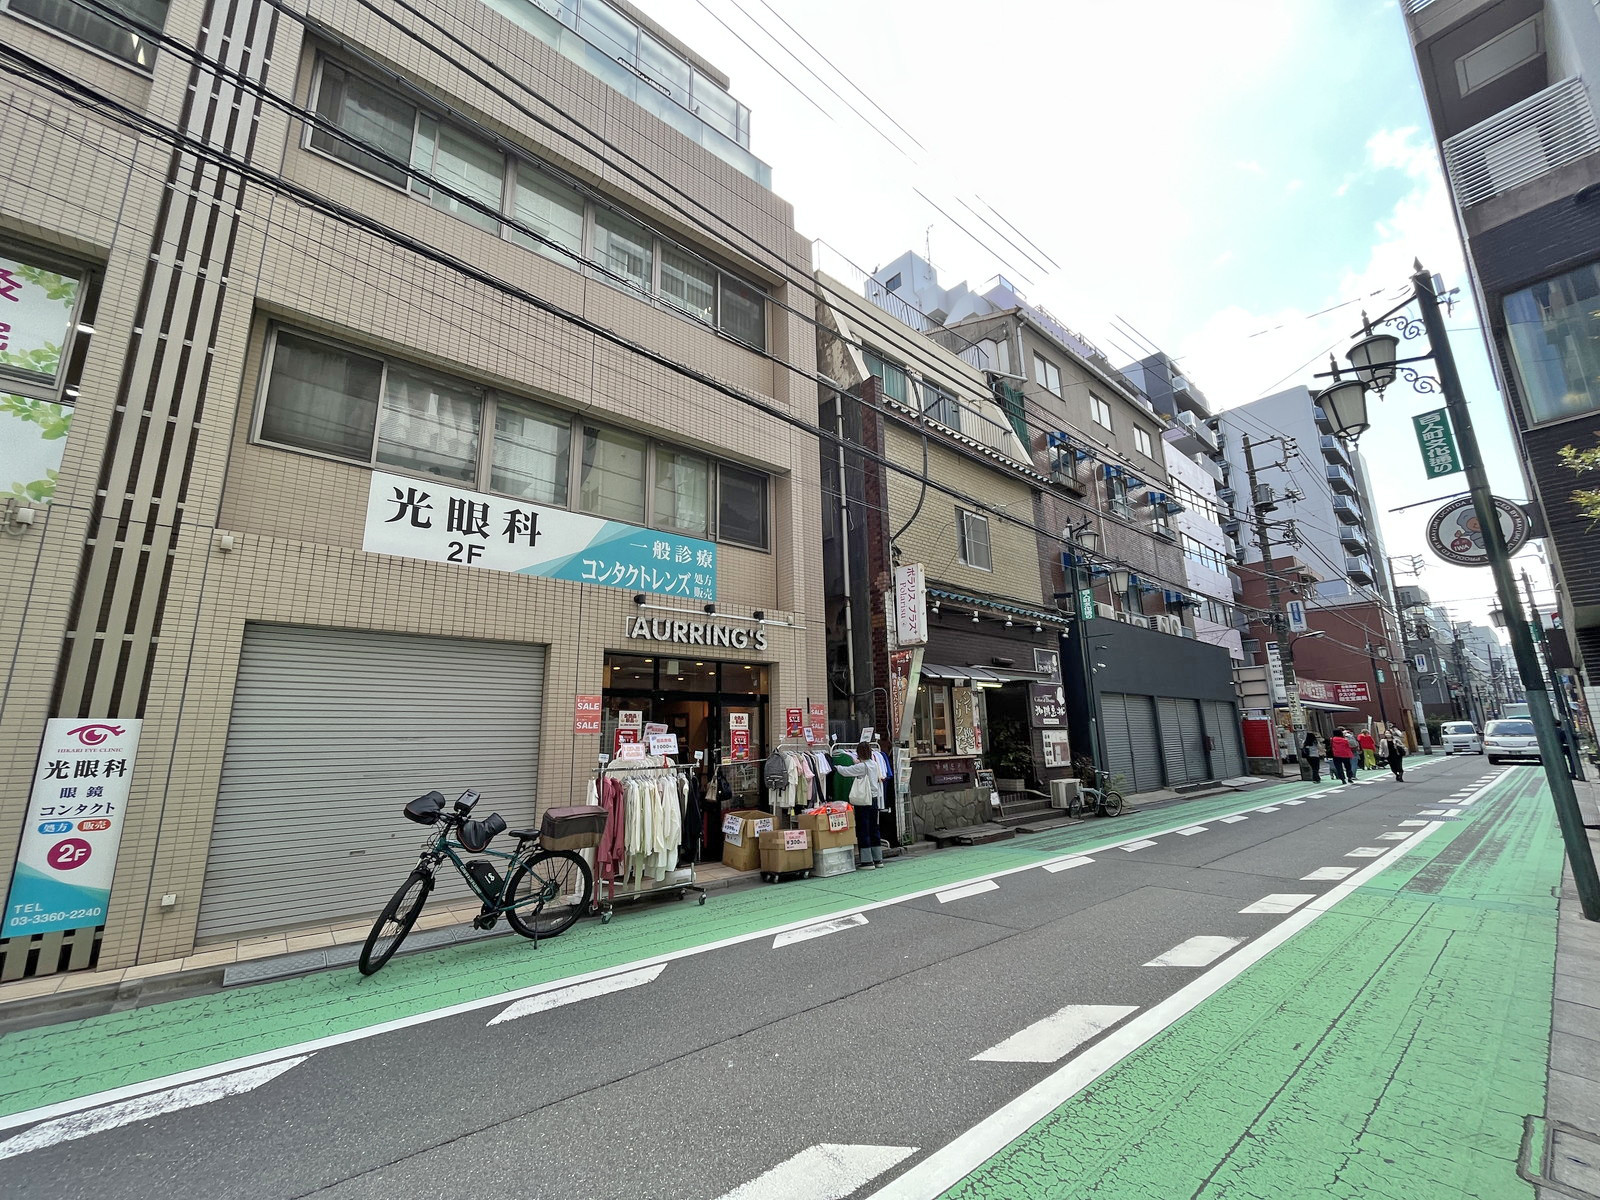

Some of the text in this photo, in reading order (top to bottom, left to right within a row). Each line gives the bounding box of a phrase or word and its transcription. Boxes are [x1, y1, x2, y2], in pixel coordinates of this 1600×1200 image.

[1418, 411, 1453, 474] 百人町文化通り
[384, 486, 542, 547] 光眼科
[447, 541, 486, 564] 2F
[629, 539, 713, 569] 一般診療
[581, 558, 713, 595] コンタクトレンズ 処方
[693, 586, 713, 600] 販売
[631, 616, 768, 651] AURRING'S
[577, 702, 600, 711] SALE
[576, 721, 599, 730] SALE
[42, 758, 127, 780] 光眼科
[59, 785, 104, 799] 眼鏡
[40, 802, 115, 816] コンタクト
[43, 820, 107, 833] 処方 販売
[57, 844, 87, 863] 2F
[10, 907, 101, 927] 03-3360-2240
[14, 902, 44, 914] TEL
